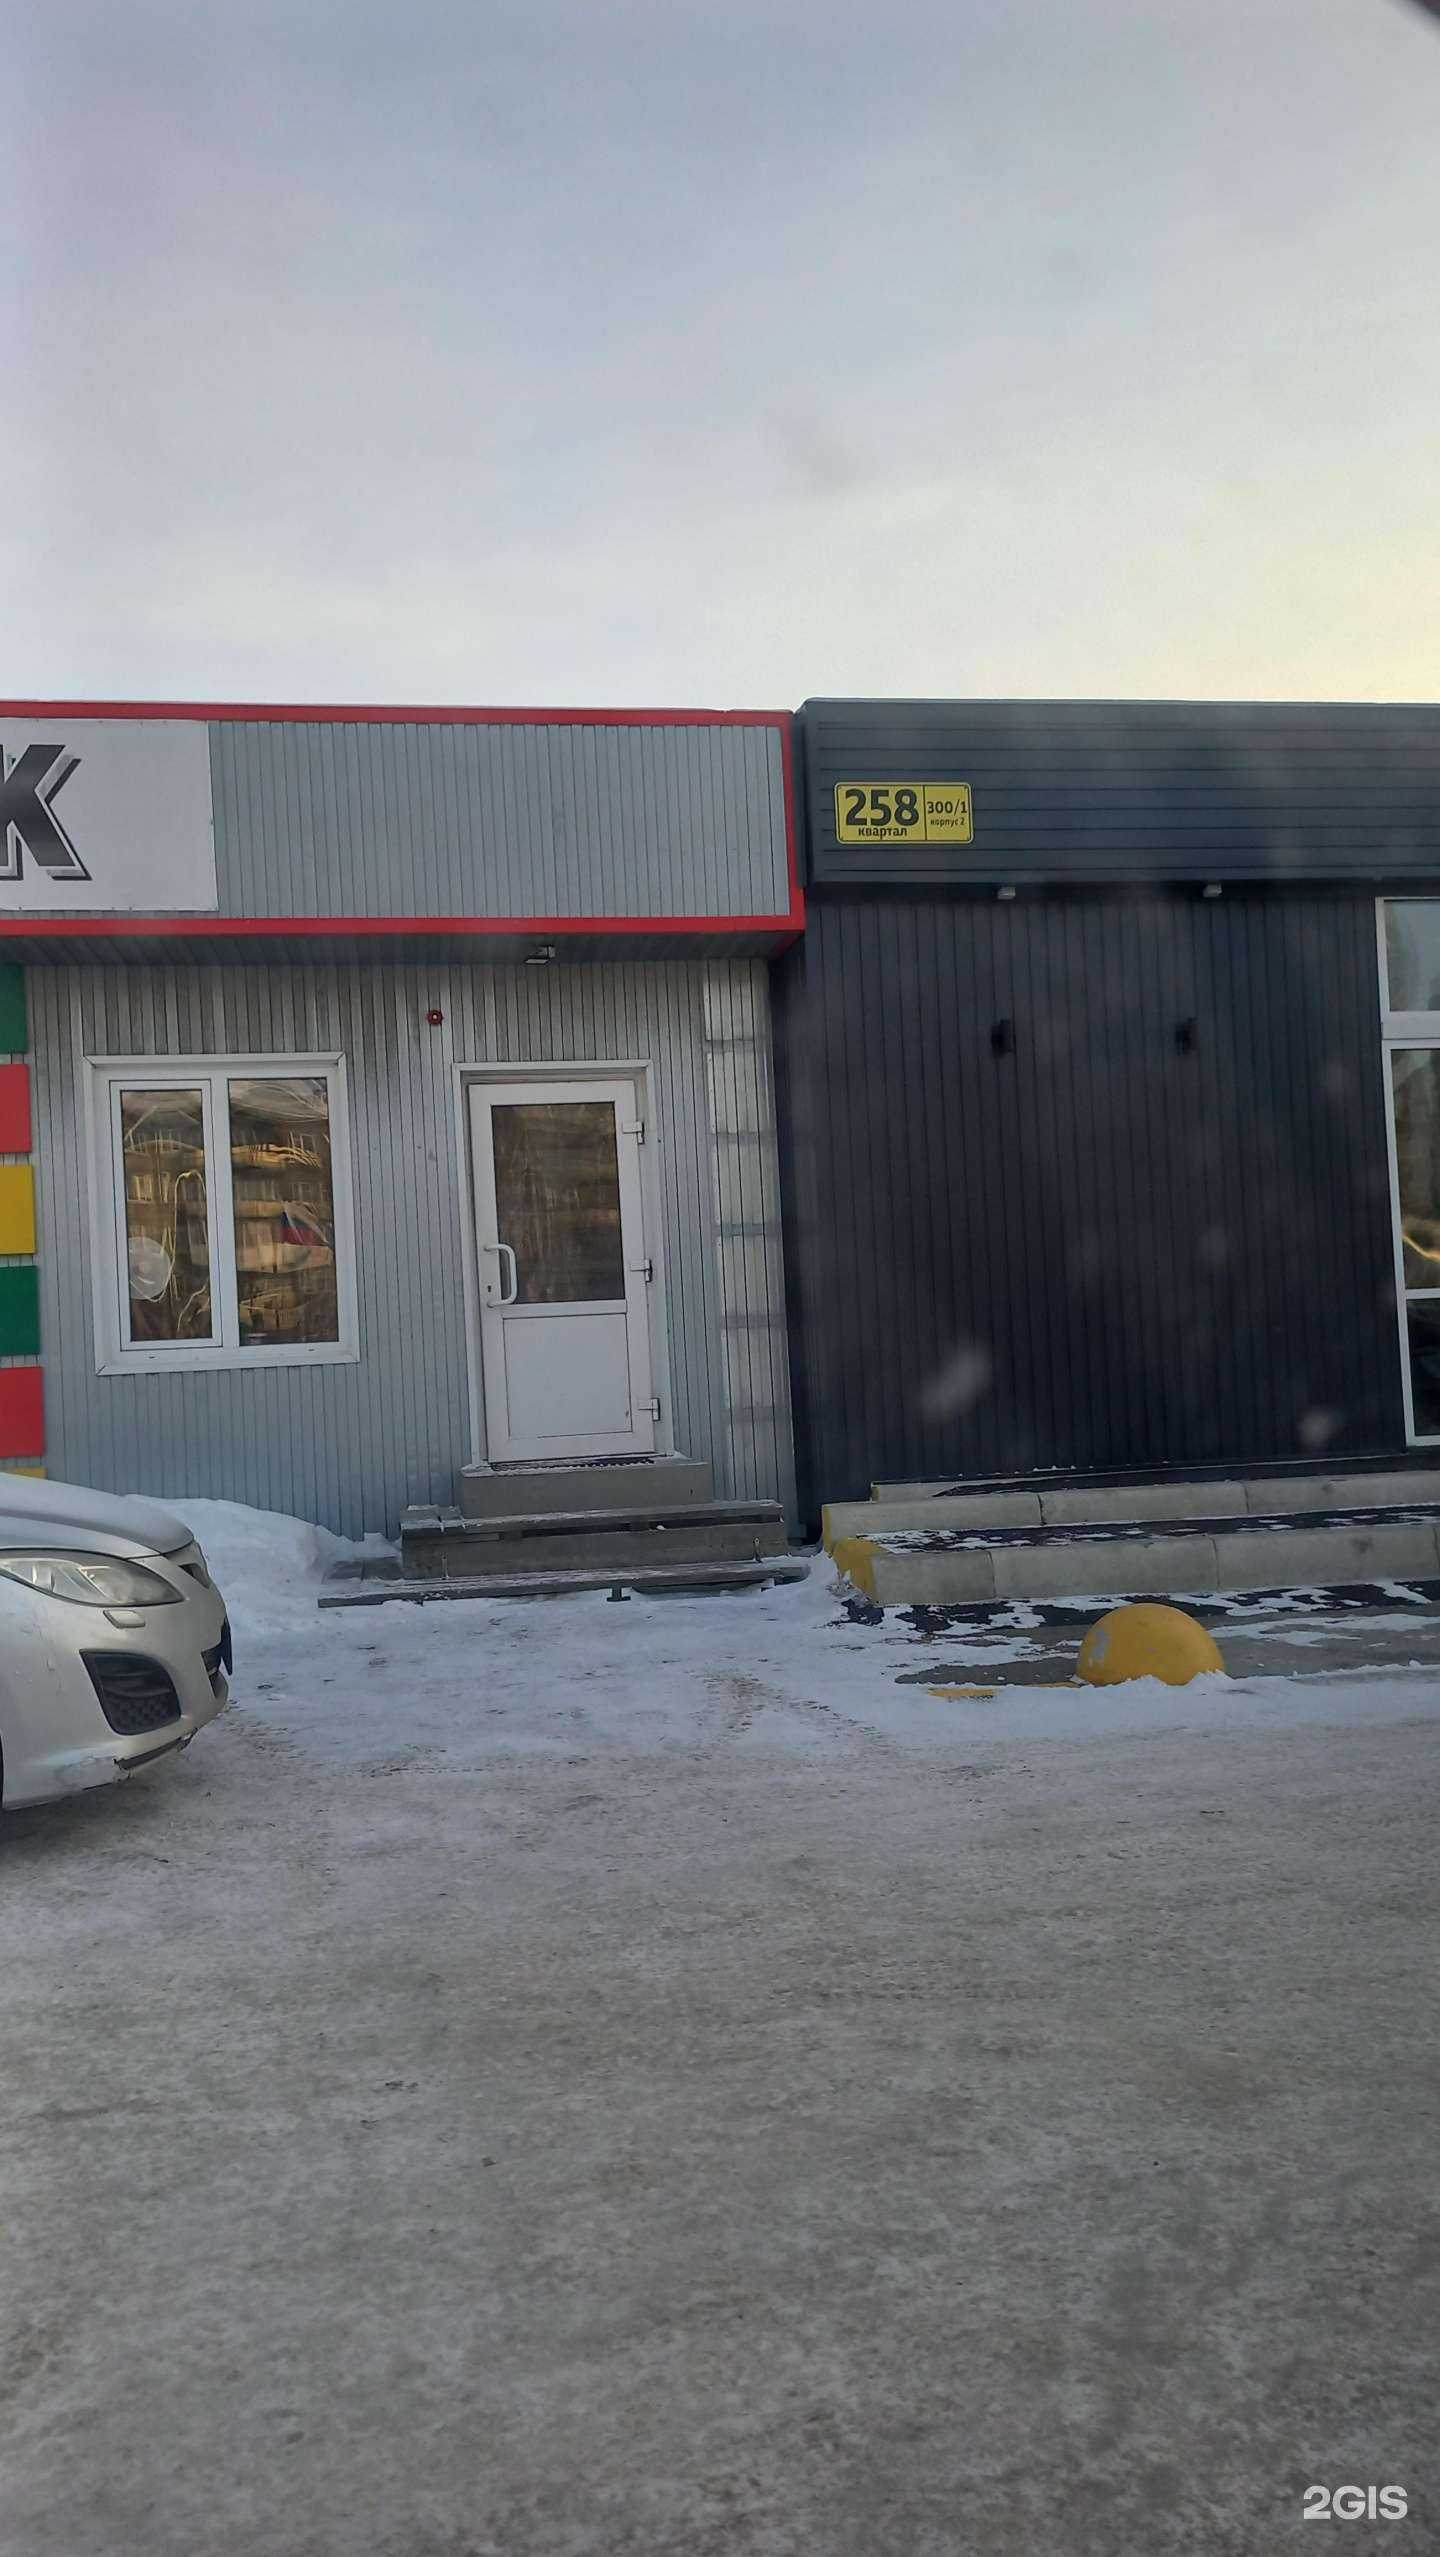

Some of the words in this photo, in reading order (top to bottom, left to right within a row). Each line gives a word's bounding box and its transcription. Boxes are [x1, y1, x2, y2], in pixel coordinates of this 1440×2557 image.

[845, 788, 919, 826] 258
[927, 799, 967, 816] 300/1
[930, 818, 958, 828] корпус
[959, 817, 965, 826] 2
[859, 827, 907, 840] квартал
